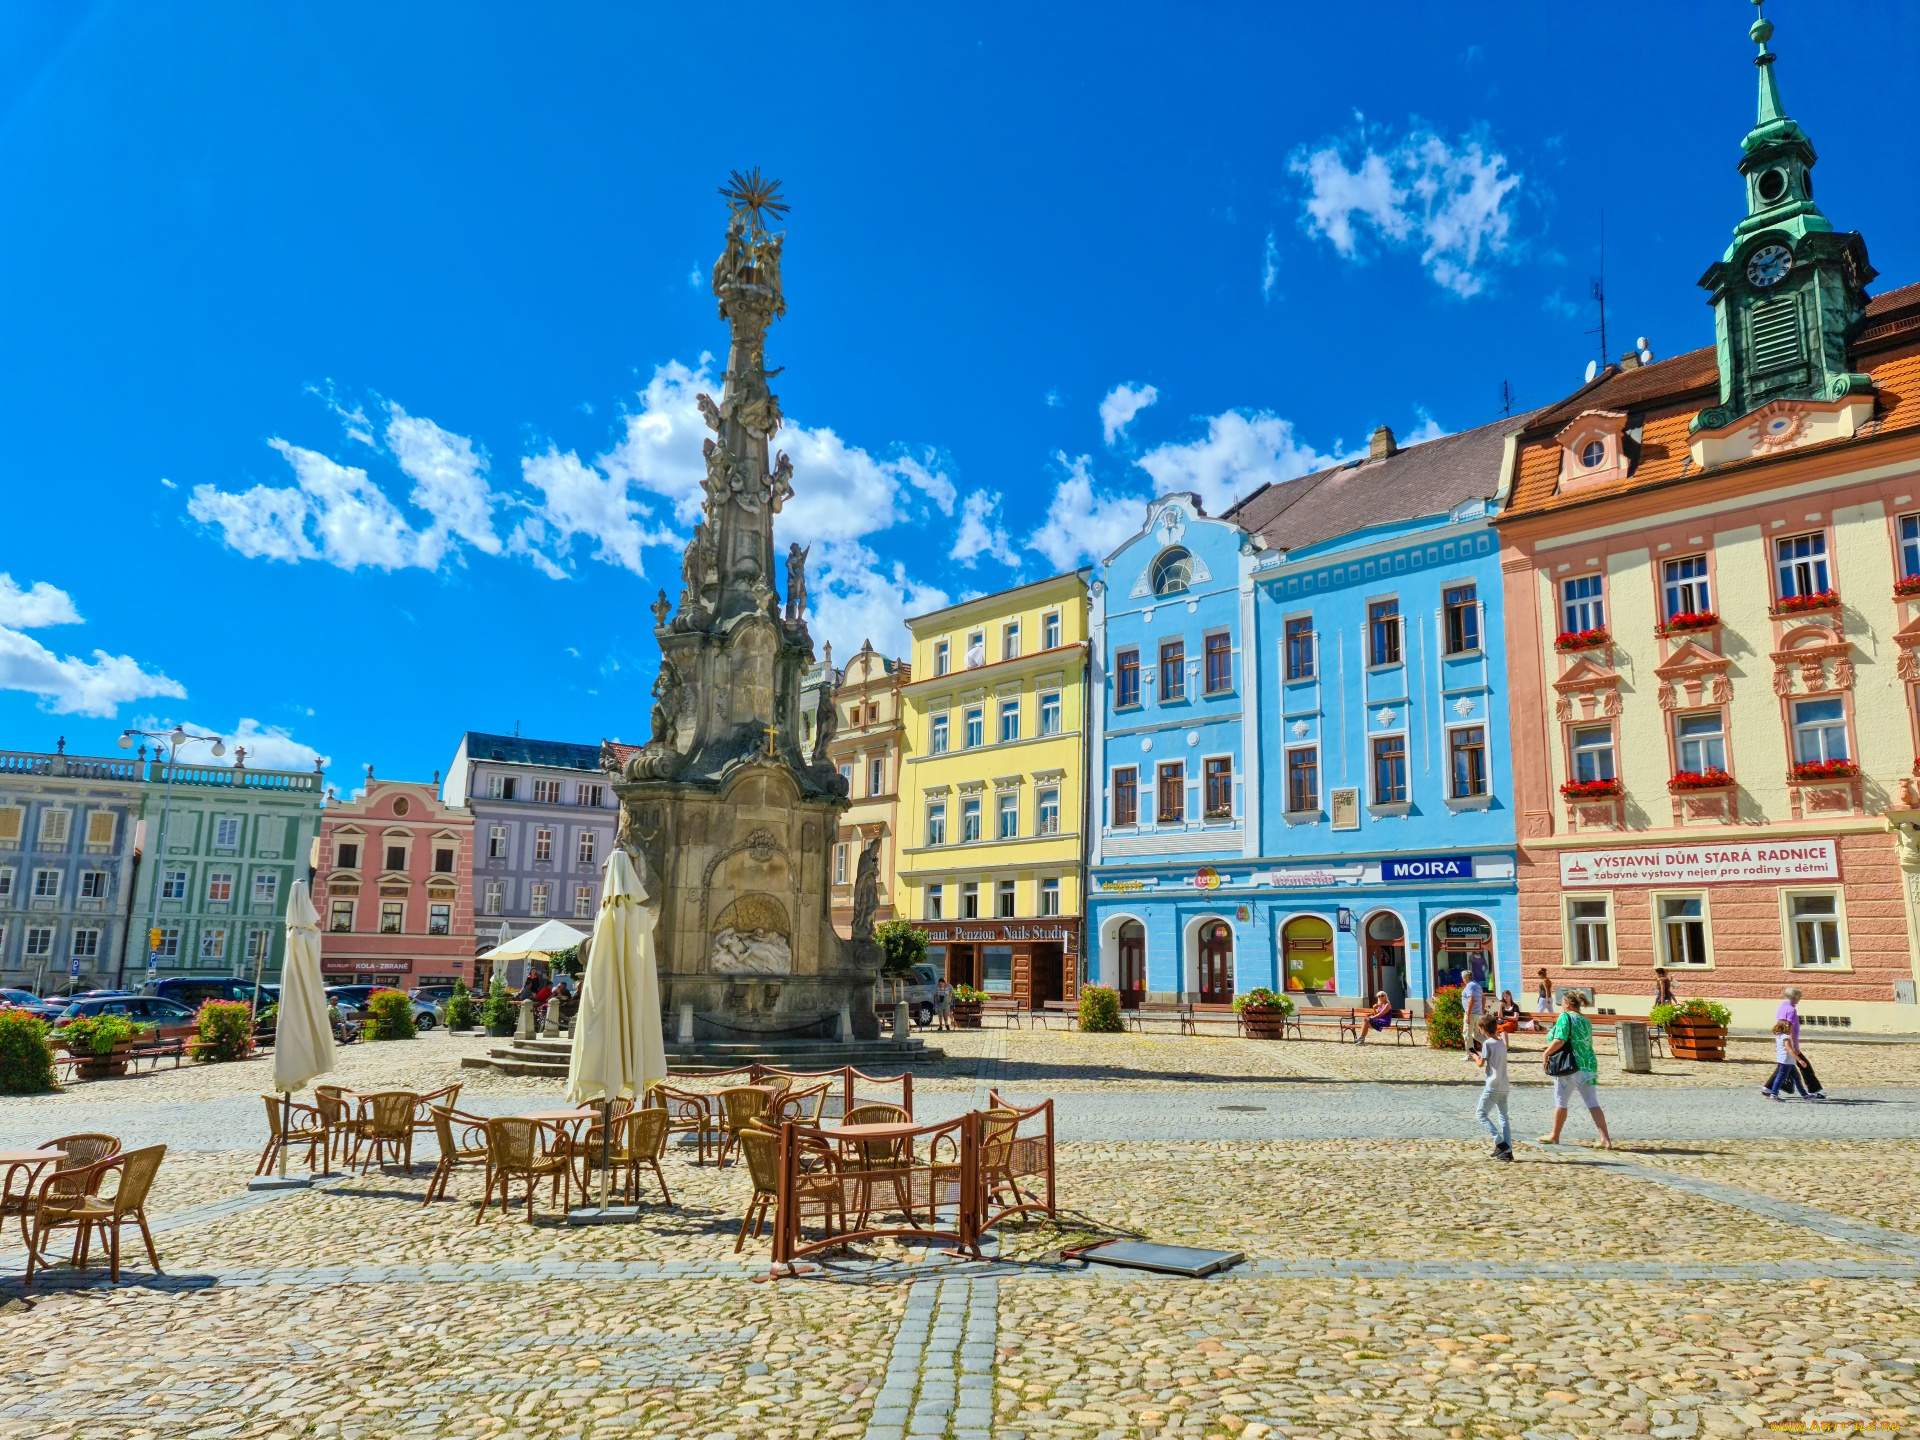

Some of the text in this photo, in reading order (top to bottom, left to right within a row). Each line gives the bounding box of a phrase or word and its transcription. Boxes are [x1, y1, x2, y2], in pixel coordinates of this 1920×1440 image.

[1594, 847, 1827, 867] VÝSTAVNÍ DŮM STARÁ RADNICE
[1394, 861, 1459, 877] MOIRA
[1595, 870, 1638, 880] zábavné
[1641, 869, 1684, 879] výstavy
[1687, 868, 1717, 878] nejen
[1720, 867, 1740, 877] pro
[1743, 865, 1781, 875] rodiny
[1197, 876, 1216, 884] teta
[1271, 870, 1334, 886] kosmetika
[1102, 879, 1143, 894] drogerie
[955, 926, 996, 940] Penzion
[1003, 925, 1031, 940] Nails
